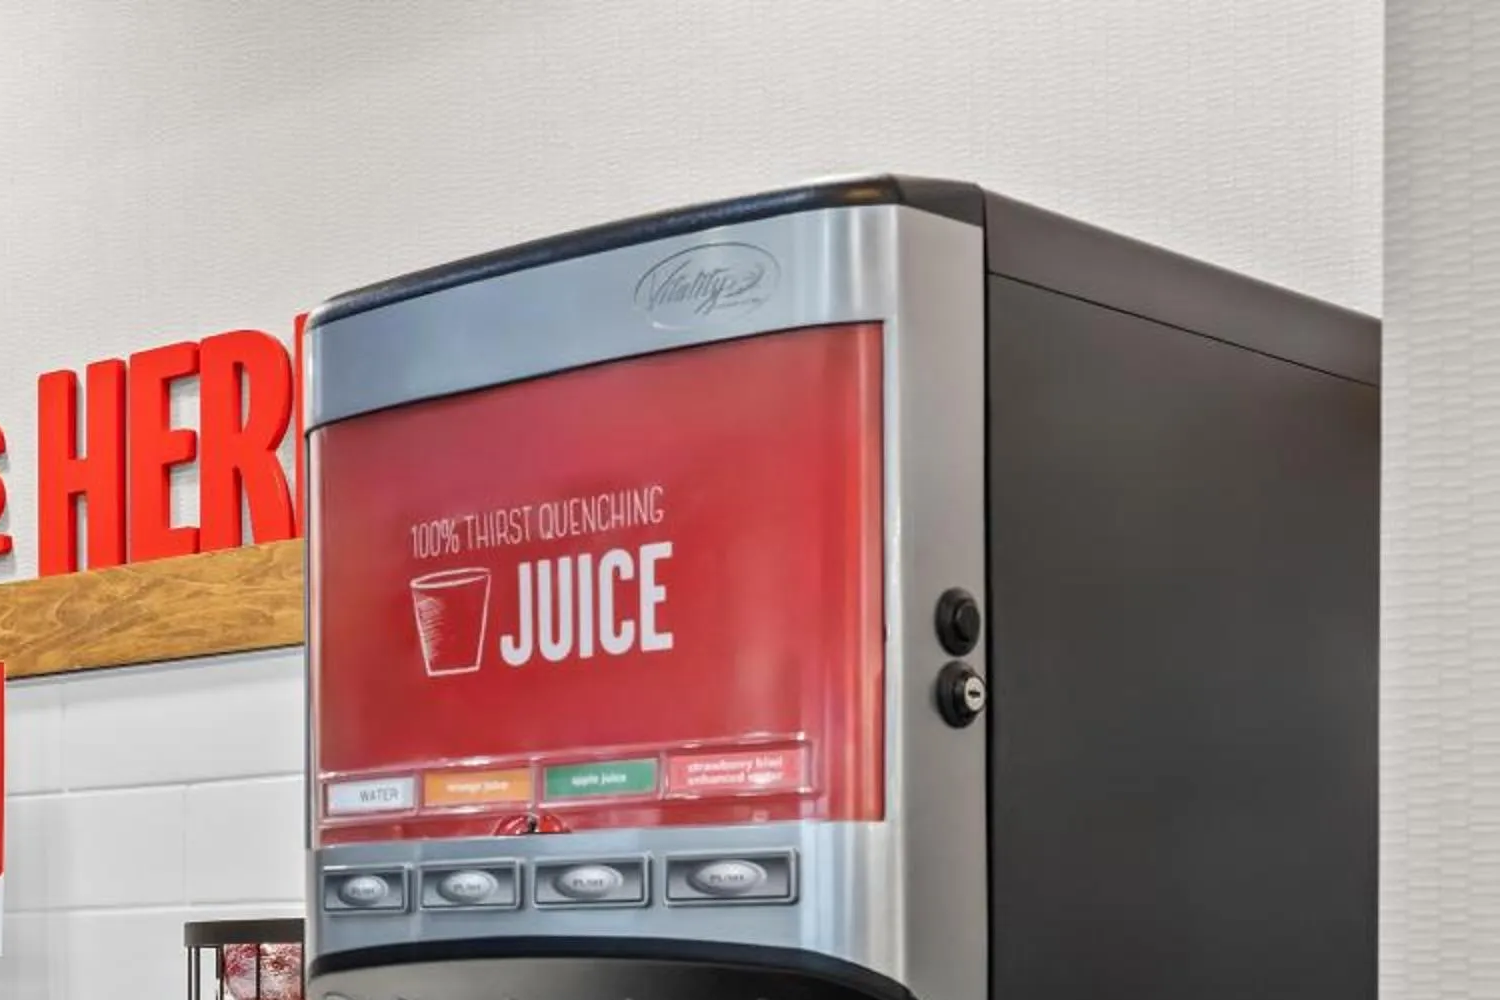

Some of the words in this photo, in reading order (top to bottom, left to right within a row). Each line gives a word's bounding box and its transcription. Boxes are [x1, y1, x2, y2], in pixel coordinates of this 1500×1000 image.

[37, 313, 305, 578] HER
[411, 517, 460, 559] 100%
[465, 505, 533, 549] THIRST
[538, 485, 665, 540] QUENCHING
[500, 541, 674, 667] JUICE
[359, 787, 400, 802] WATER
